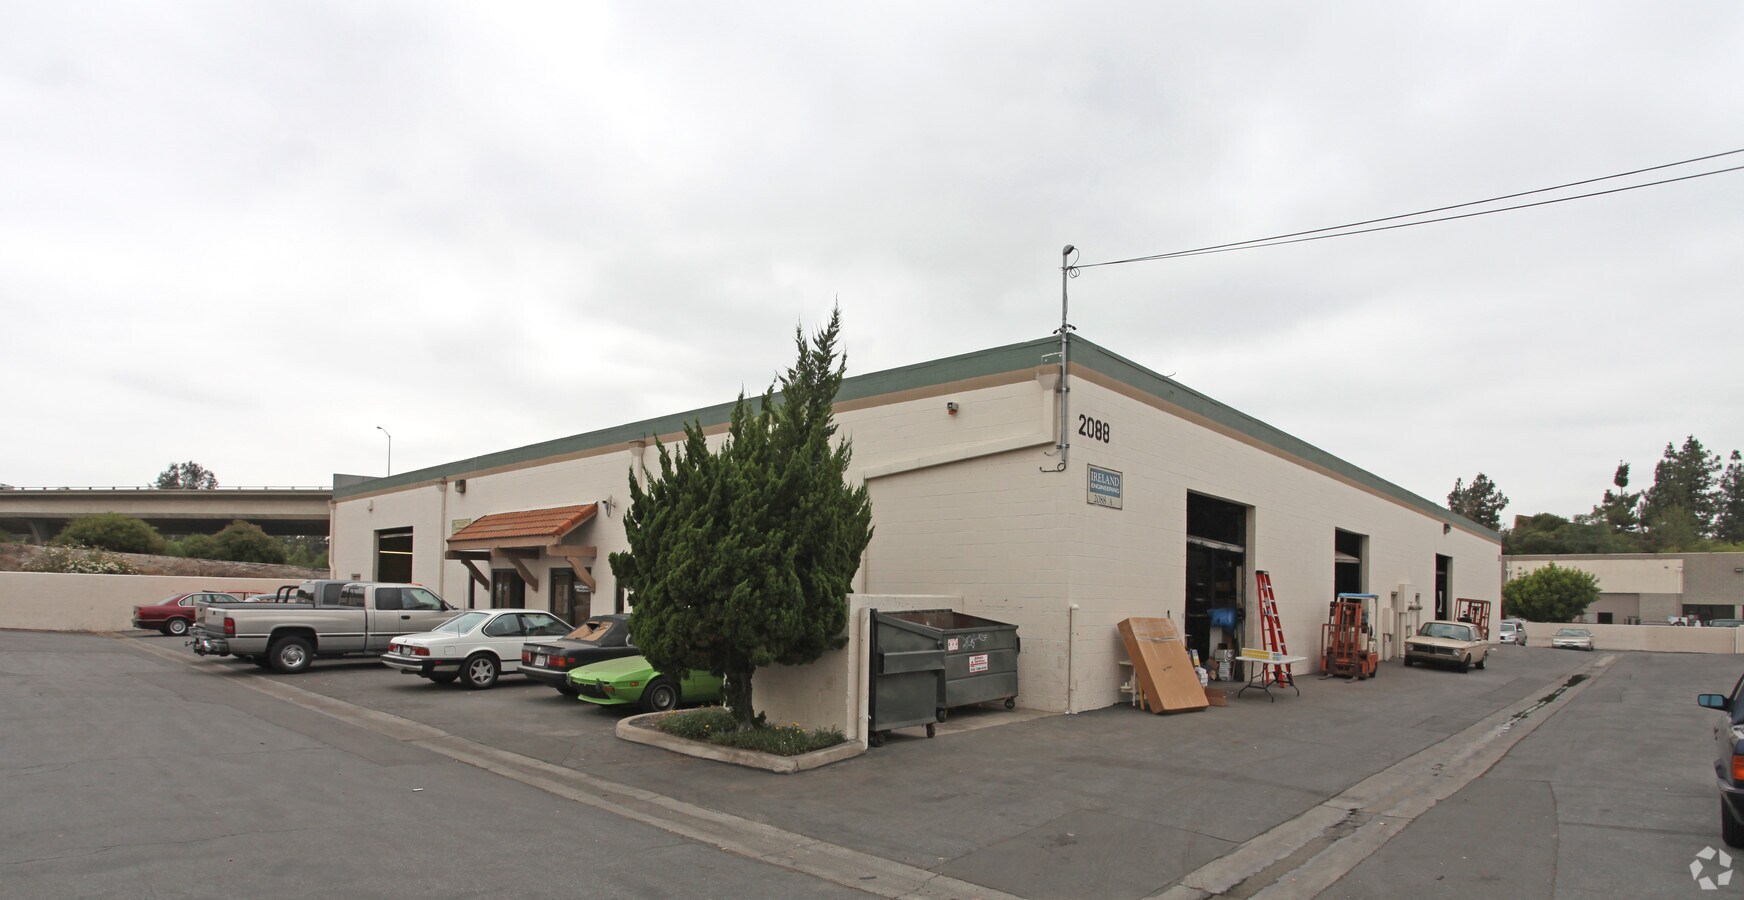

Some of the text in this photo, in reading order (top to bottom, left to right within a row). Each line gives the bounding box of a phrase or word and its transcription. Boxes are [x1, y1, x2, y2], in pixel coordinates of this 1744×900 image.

[1078, 413, 1110, 444] 2088
[1091, 471, 1120, 487] IRELAND
[1091, 482, 1120, 494] ENGINEERING
[1093, 494, 1107, 505] 2088
